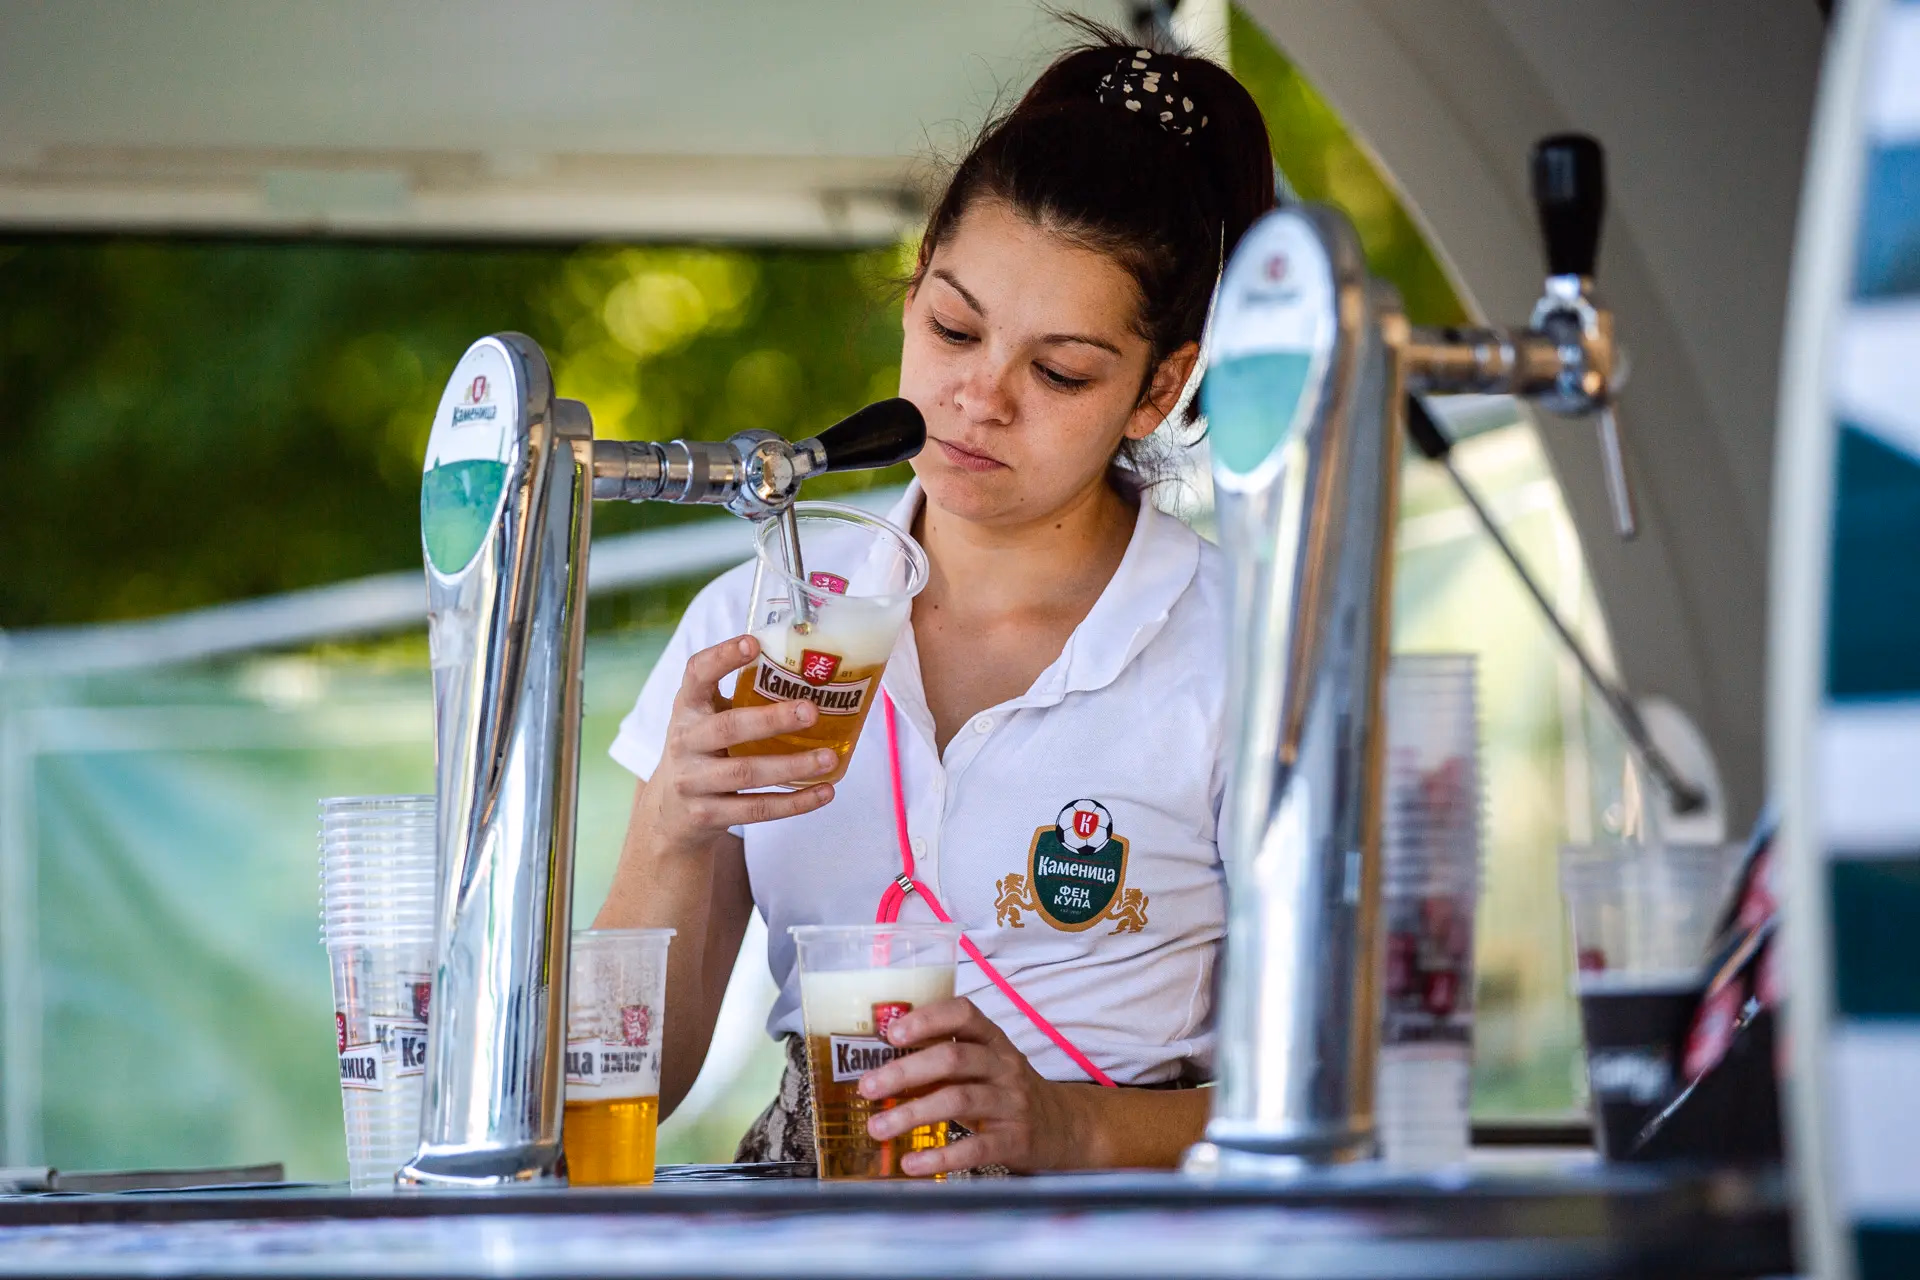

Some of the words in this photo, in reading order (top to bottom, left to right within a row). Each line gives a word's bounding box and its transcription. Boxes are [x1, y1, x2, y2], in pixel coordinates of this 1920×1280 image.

[759, 662, 863, 711] Каменица
[1038, 855, 1116, 884] Каменица
[1053, 895, 1091, 909] КУПА
[1059, 885, 1090, 899] ФЕН
